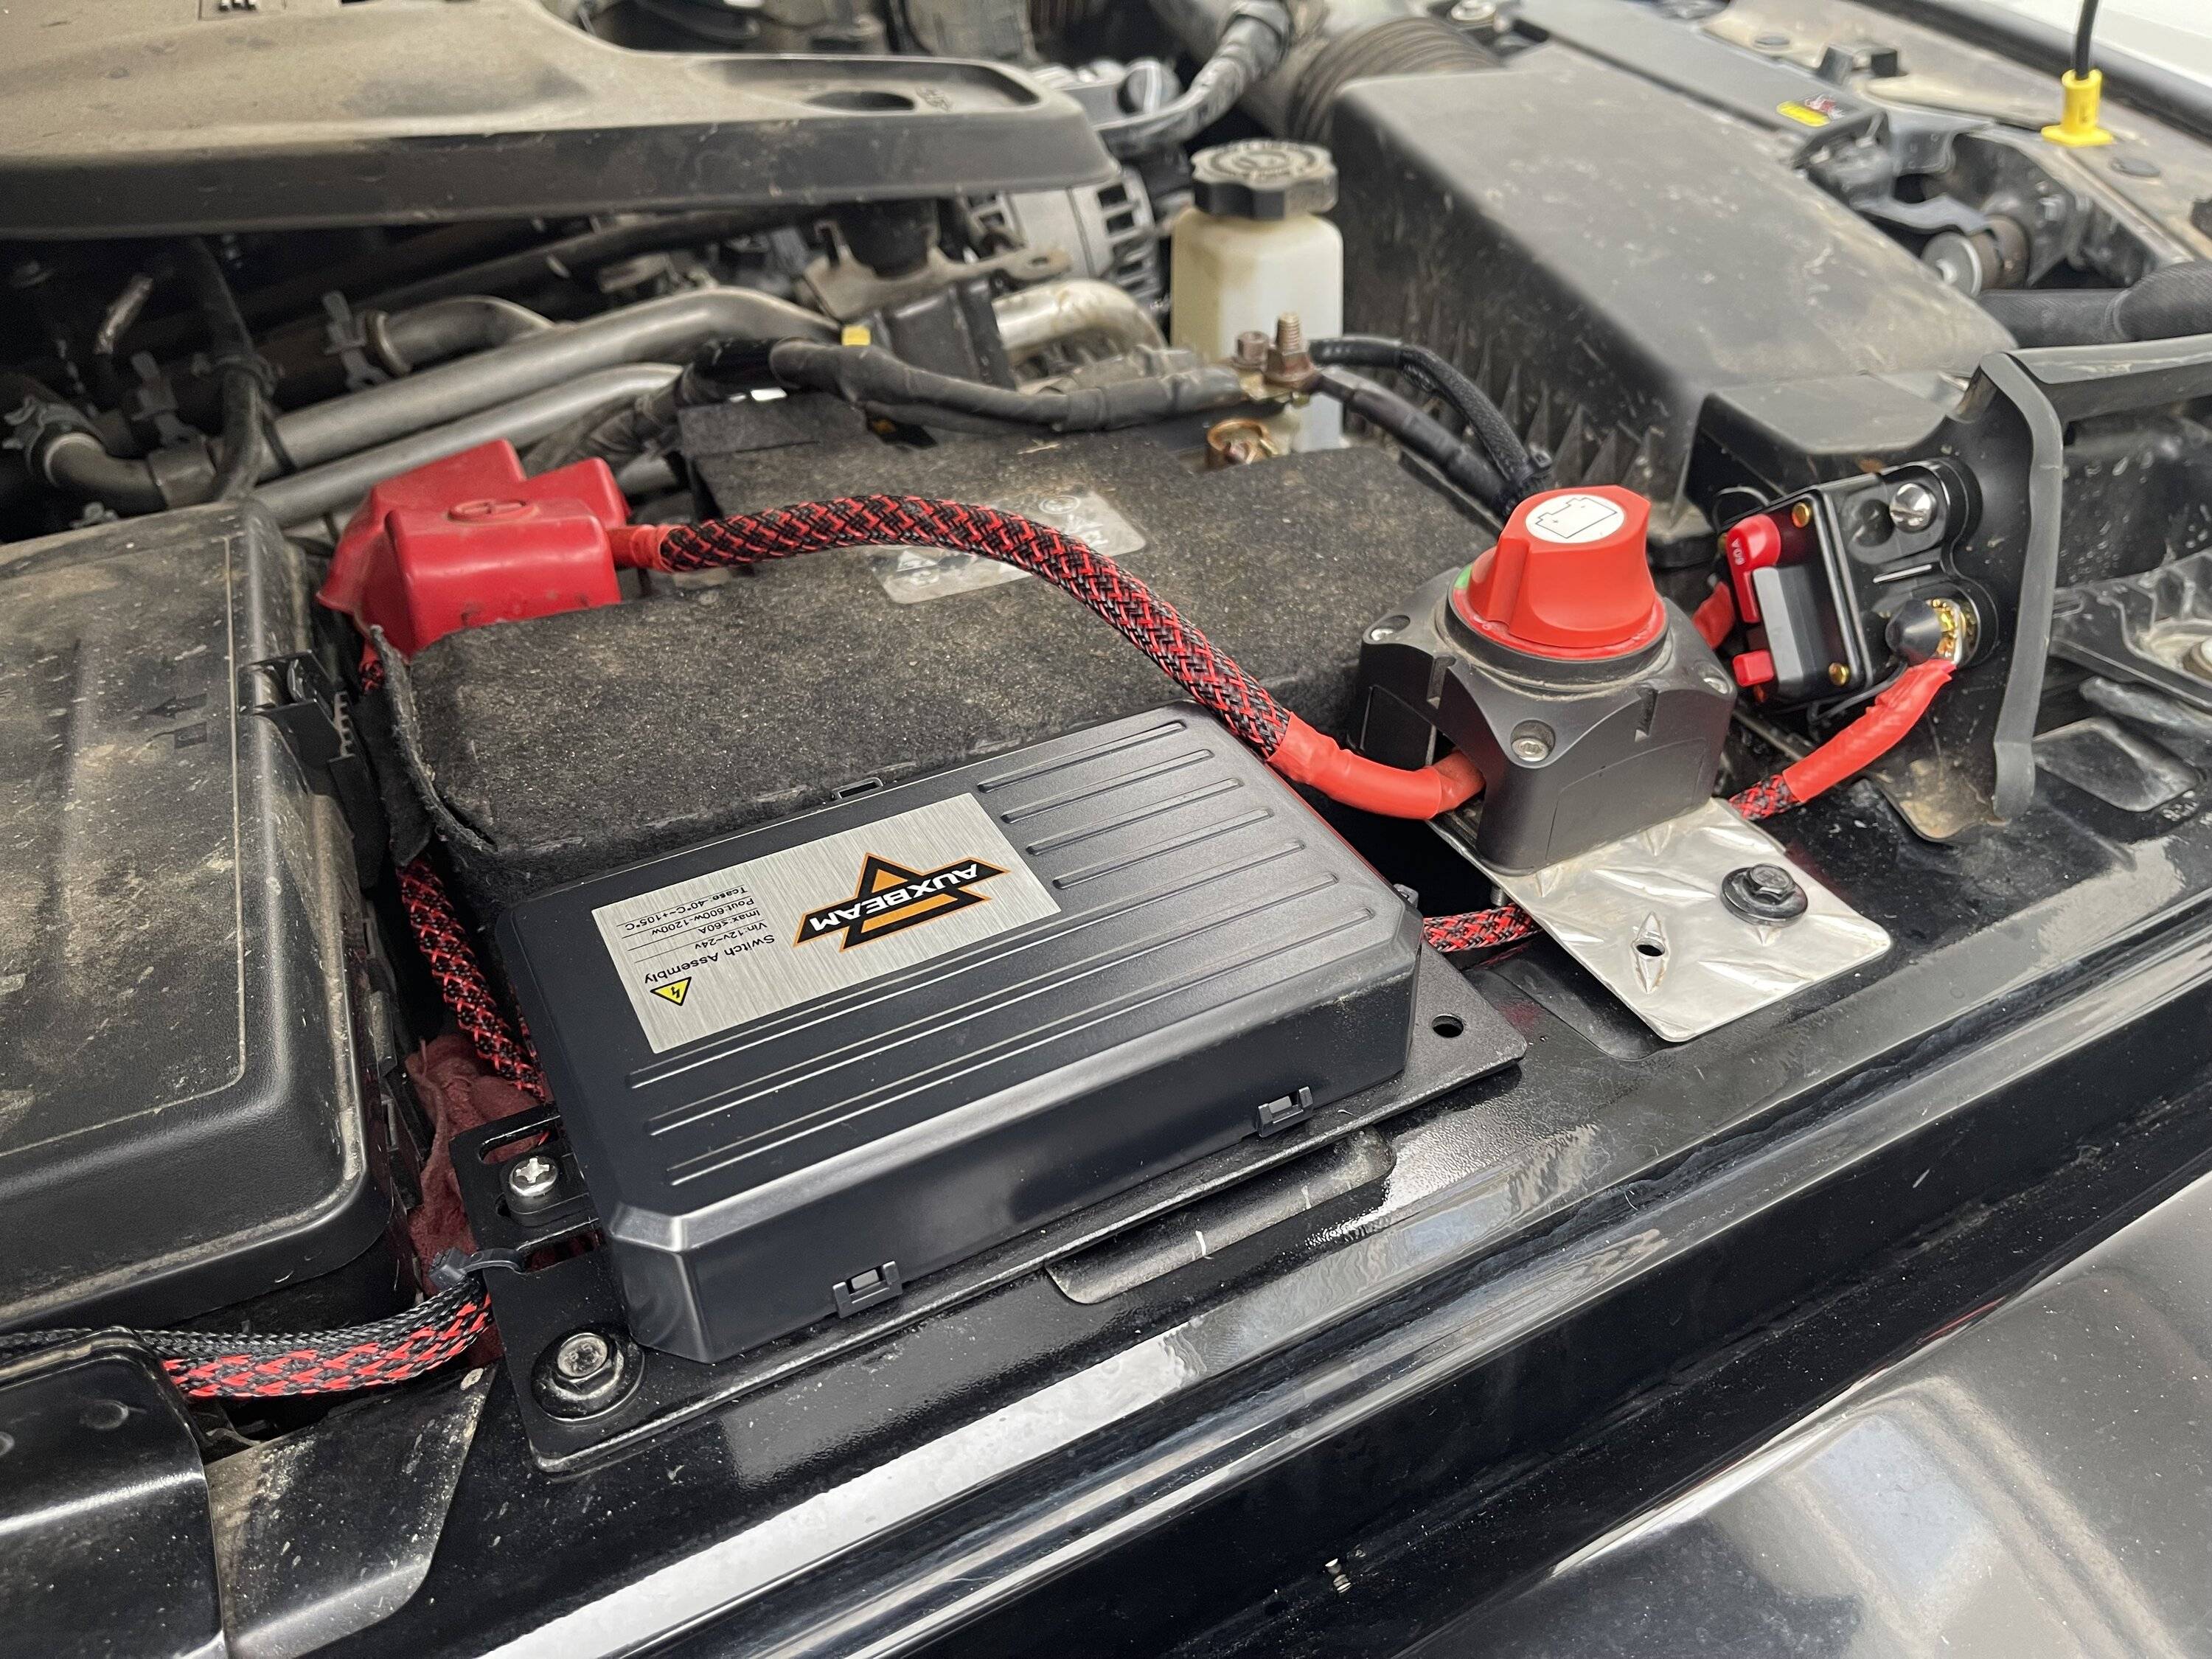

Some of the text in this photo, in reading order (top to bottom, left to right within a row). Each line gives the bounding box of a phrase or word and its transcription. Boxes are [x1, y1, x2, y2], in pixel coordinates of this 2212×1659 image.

[652, 897, 754, 935] Pout:600w-1200w
[809, 863, 980, 931] AUXBEAM
[695, 922, 768, 950] Vin:12v~24v
[644, 934, 775, 984] Switch Assembly
